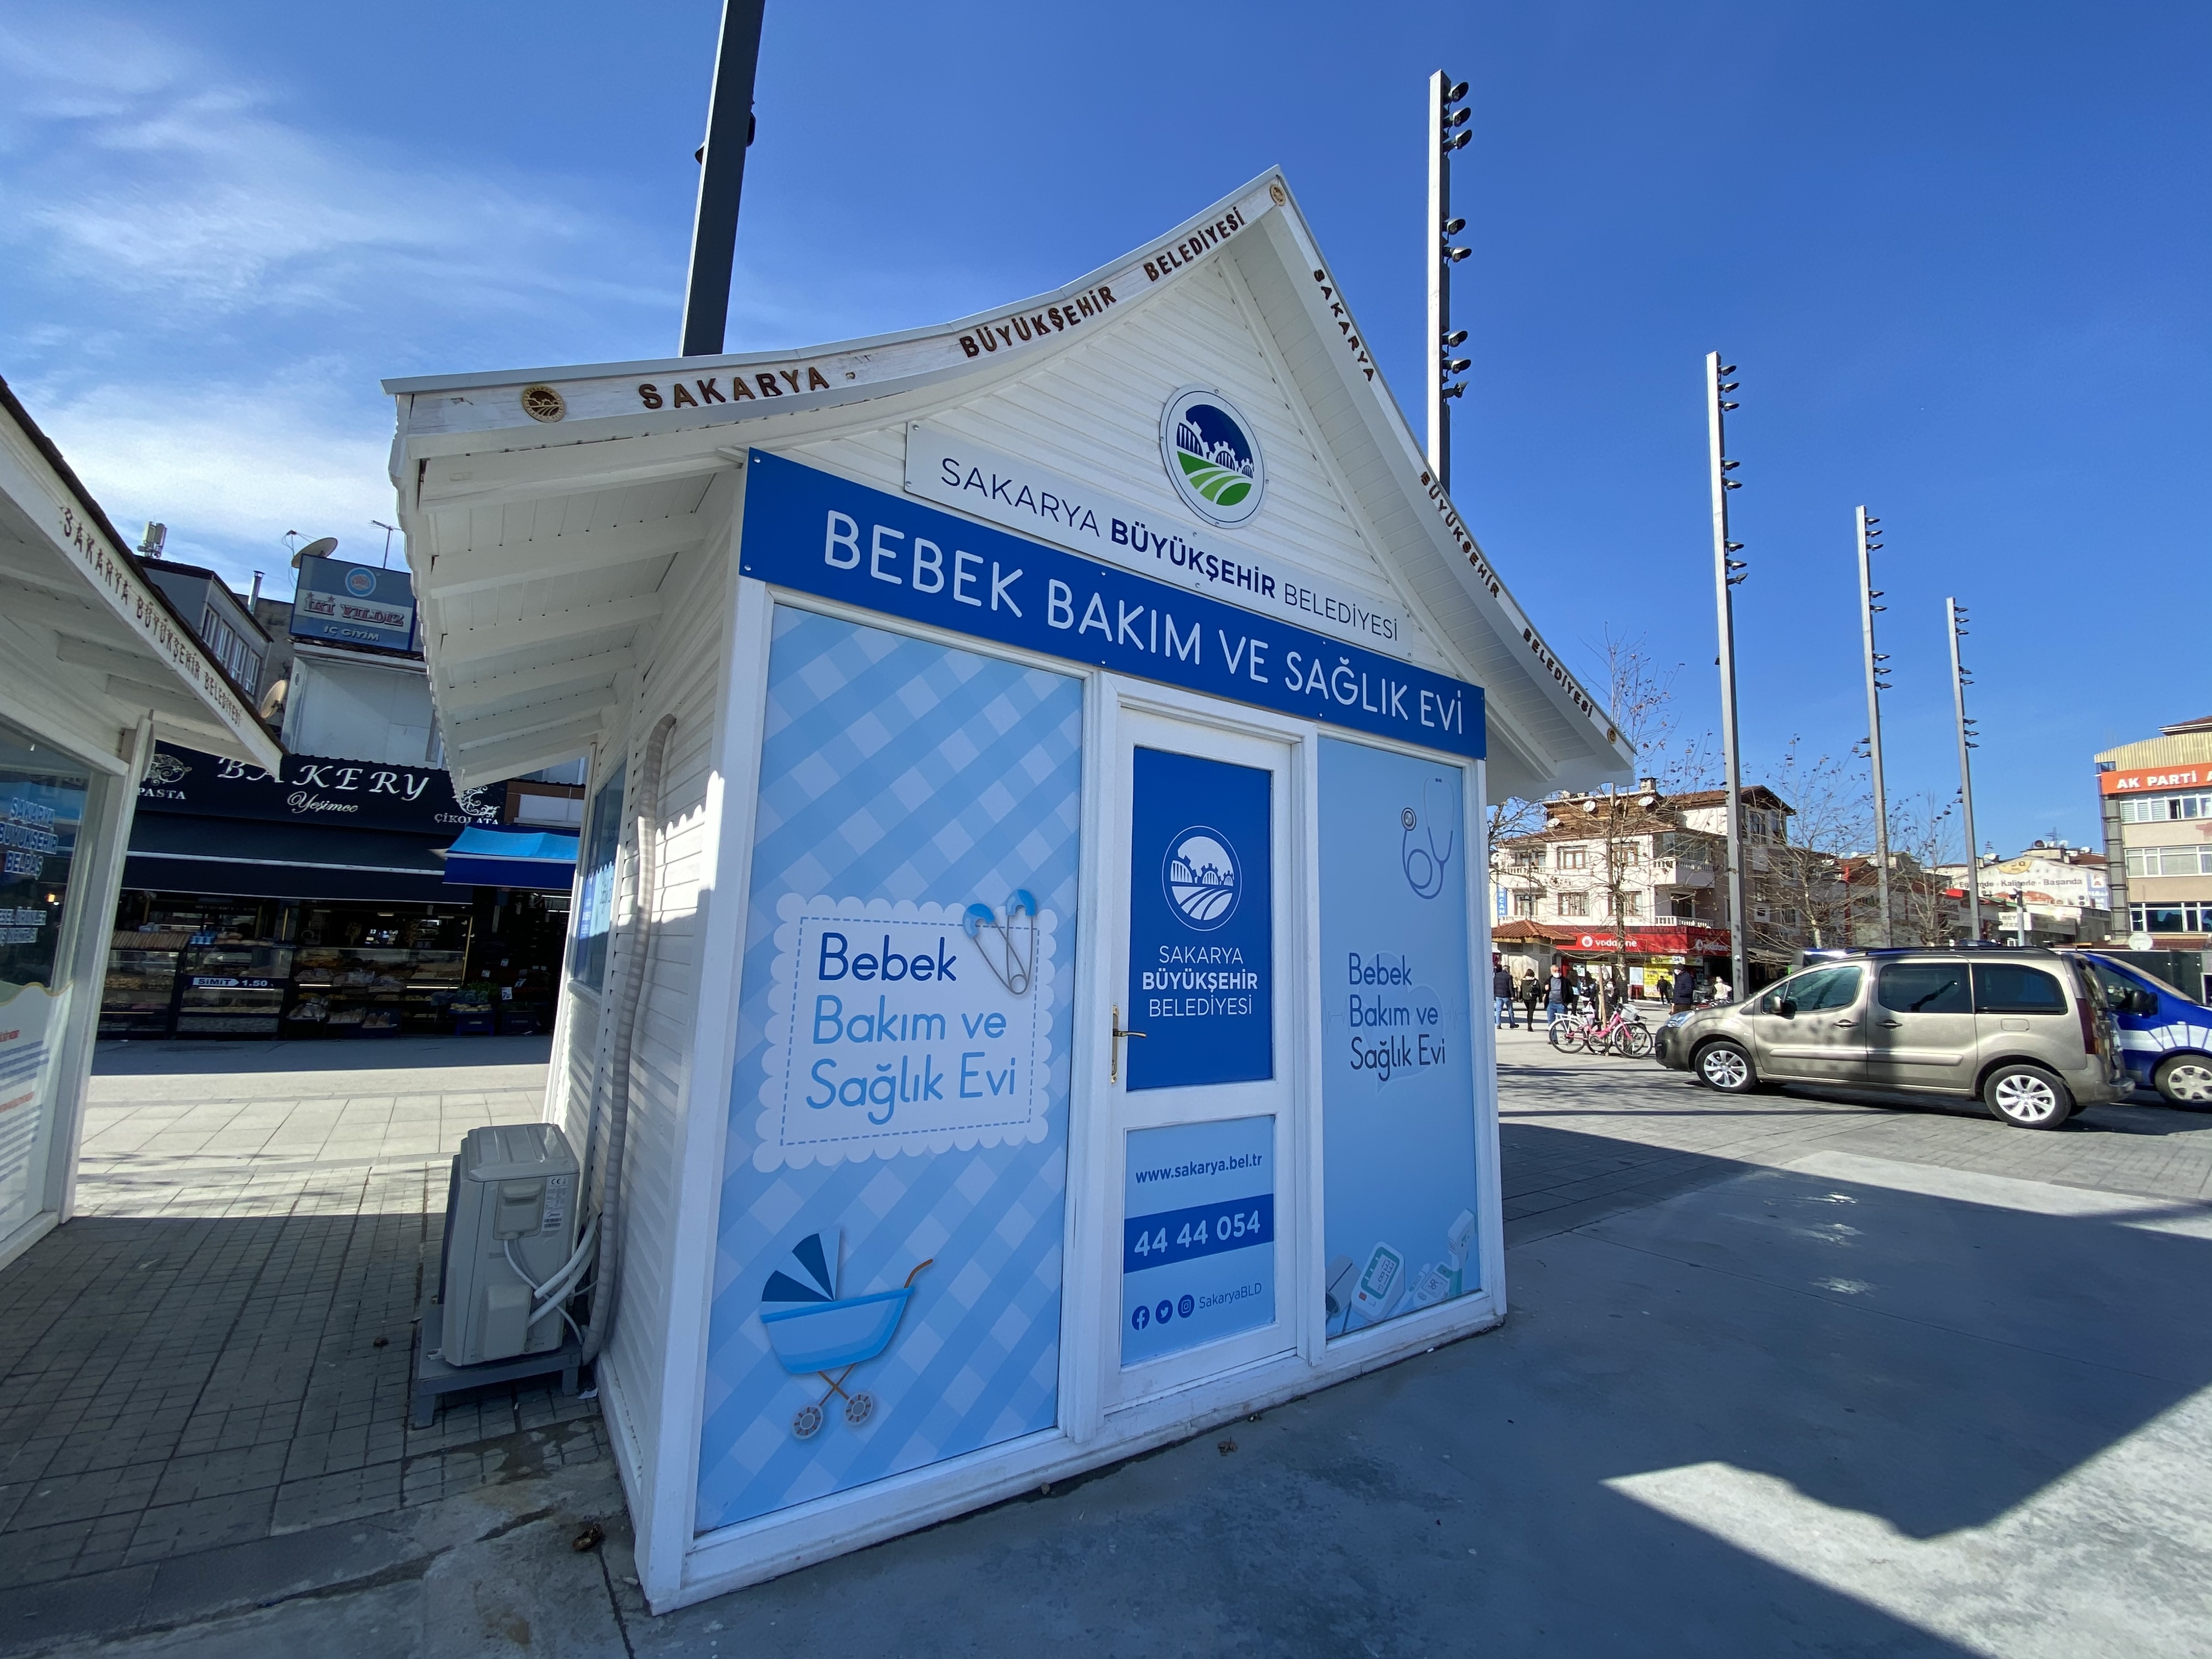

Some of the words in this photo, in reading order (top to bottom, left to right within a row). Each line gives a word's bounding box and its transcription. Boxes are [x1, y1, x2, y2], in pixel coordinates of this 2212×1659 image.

[637, 366, 830, 409] SAKARYA
[959, 285, 1116, 358] BÜYÜKŞEHİR
[1143, 206, 1246, 282] BELEDİYESİ
[1314, 268, 1374, 382] SAKARYA
[1420, 471, 1500, 598] BÜYÜKŞEHİR
[1523, 627, 1594, 719] BELEDİYESİ
[941, 458, 1100, 538] SAKARYA
[1111, 517, 1276, 600] BÜYÜKŞEHİR
[1284, 583, 1399, 641] BELEDİYESİ
[64, 508, 130, 605] SAKARYA
[137, 595, 200, 680] BÜYÜKŞEHİR
[341, 603, 404, 627] YILDIZ
[341, 629, 380, 641] GİYİM
[825, 510, 1024, 618] BEBEK
[1047, 578, 1200, 665] BAKIM
[1218, 629, 1269, 684] VE
[1285, 651, 1409, 720] SAĞLIK
[1420, 690, 1463, 735] EVİ
[2117, 777, 2140, 789] AK
[2147, 770, 2197, 787] PARTİ
[819, 932, 957, 981] Bebek
[1159, 945, 1243, 965] SAKARYA
[1349, 952, 1412, 986] Bebek
[1143, 968, 1258, 992] BÜYÜKŞEHİR
[813, 995, 946, 1043] Bakım
[961, 1012, 1007, 1039] ve
[1149, 994, 1252, 1017] BELEDİYESİ
[1350, 994, 1410, 1027] Bakım
[1416, 1007, 1438, 1025] ve
[1350, 1035, 1413, 1082] Sağlık
[1418, 1034, 1446, 1065] Evi
[806, 1054, 944, 1125] Sağlık
[960, 1052, 1015, 1098] Evi
[1135, 1153, 1262, 1184] www.sakarya.bel.tr
[1134, 1227, 1168, 1256] 44
[1177, 1220, 1208, 1248] 44
[1216, 1210, 1261, 1241] 054
[1199, 1282, 1262, 1310] SakaryaBLD
